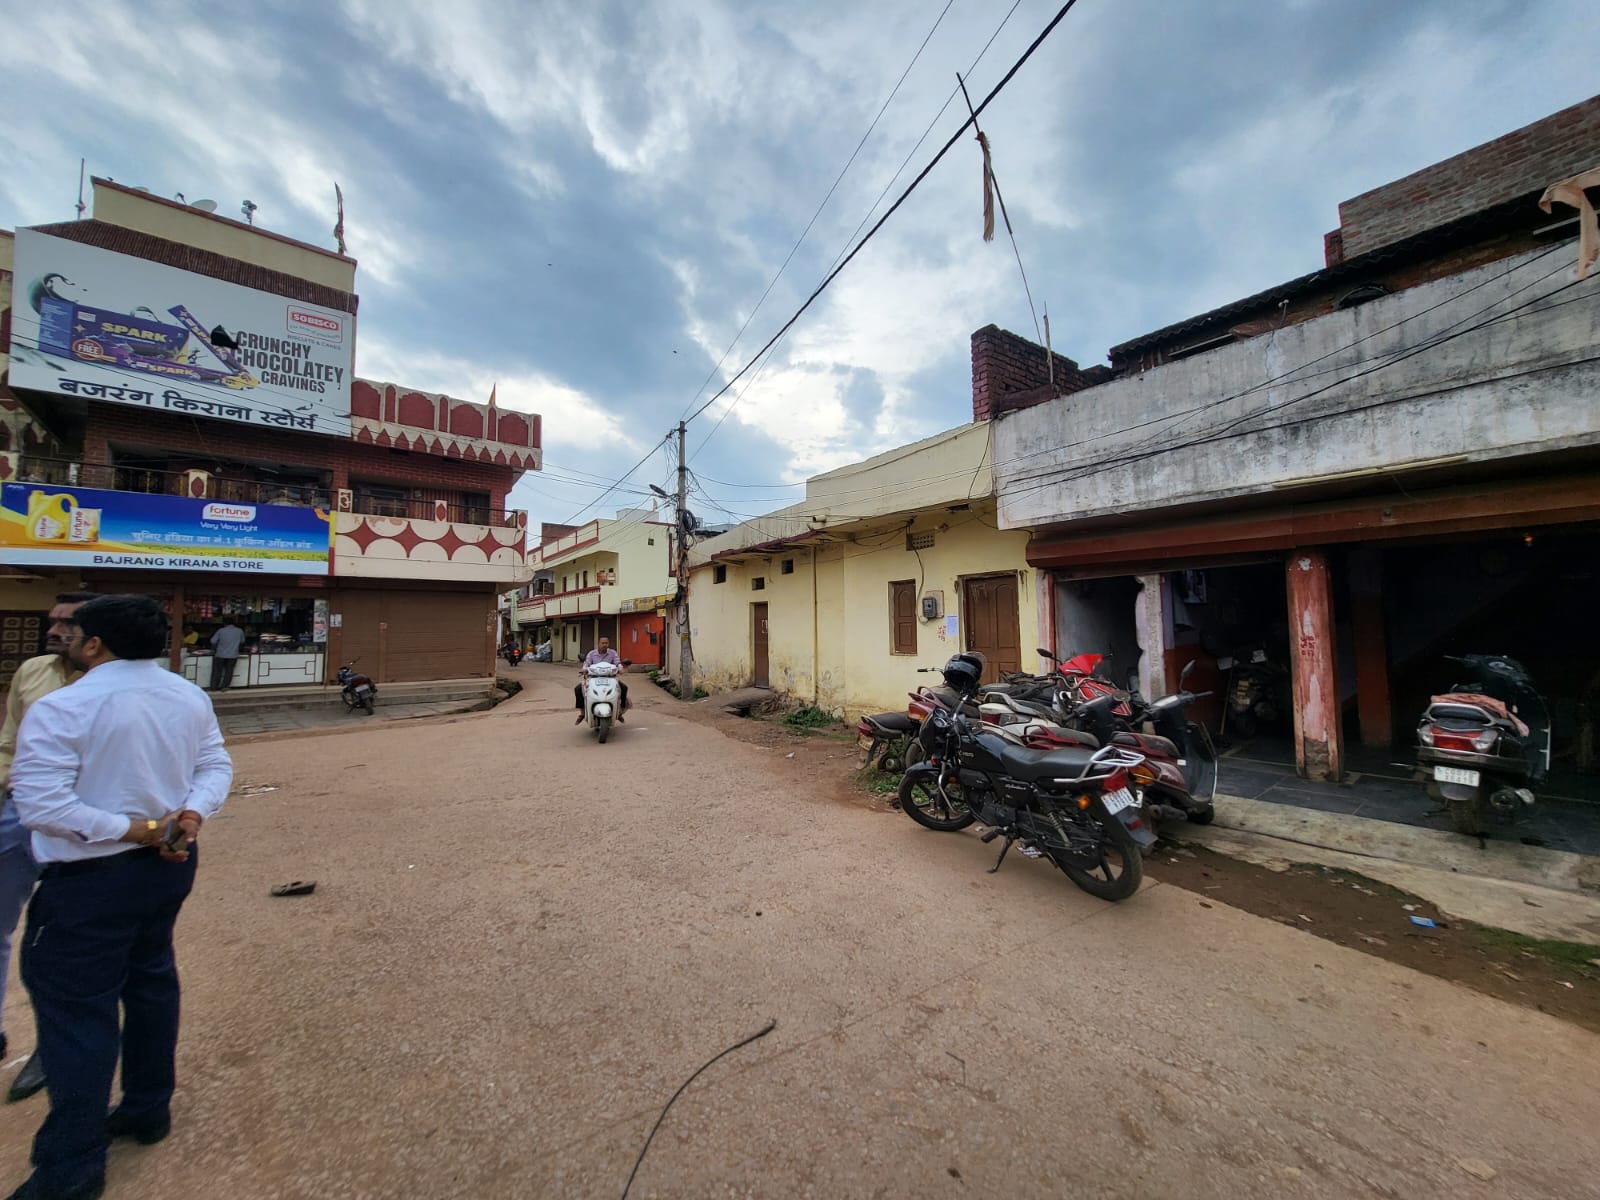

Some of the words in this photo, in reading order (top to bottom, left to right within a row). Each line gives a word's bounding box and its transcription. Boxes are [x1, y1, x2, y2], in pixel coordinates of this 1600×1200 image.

[293, 314, 337, 329] SOBISCO
[101, 322, 168, 342] SPARK
[78, 343, 100, 355] FREE
[237, 331, 311, 359] CRUNCHY
[149, 364, 194, 377] SPARK
[235, 348, 344, 383] CHOCOLATEY
[261, 371, 326, 393] CRAVINGS
[58, 377, 154, 404] बजरंग
[162, 390, 252, 420] किराना
[259, 408, 319, 430] स्टोर्स
[209, 505, 250, 516] fortune
[72, 511, 84, 538] fortune
[200, 521, 219, 531] Very
[220, 522, 238, 532] Very
[239, 523, 258, 532] Light
[93, 555, 164, 566] BAJRANG
[169, 558, 220, 568] KIRANA
[223, 560, 264, 569] STORE
